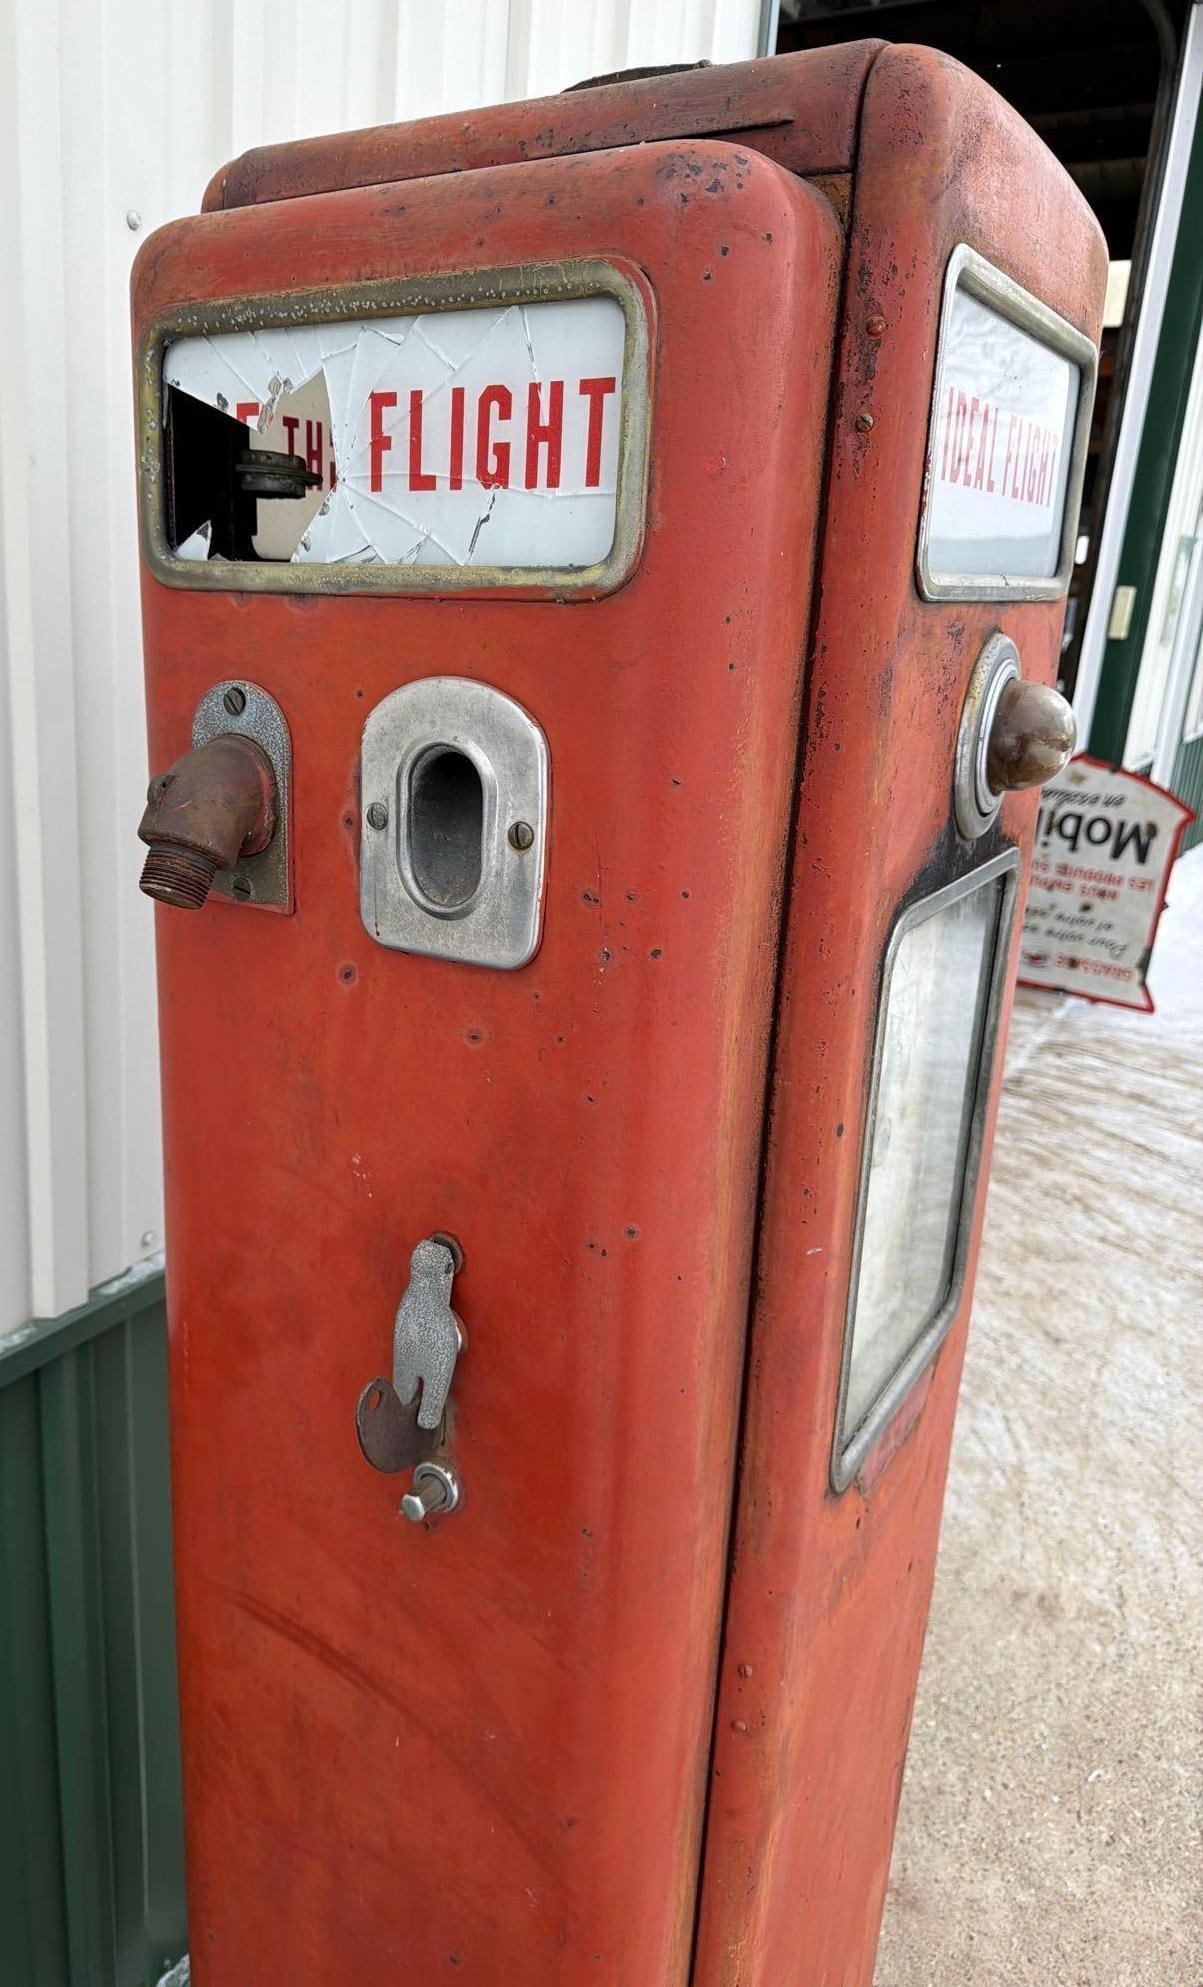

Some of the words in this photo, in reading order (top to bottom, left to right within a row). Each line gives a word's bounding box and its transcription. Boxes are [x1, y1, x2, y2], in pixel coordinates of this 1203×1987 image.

[369, 376, 616, 493] FLIGHT
[941, 386, 999, 493] IDEAL
[1001, 413, 1059, 507] FLIGHT
